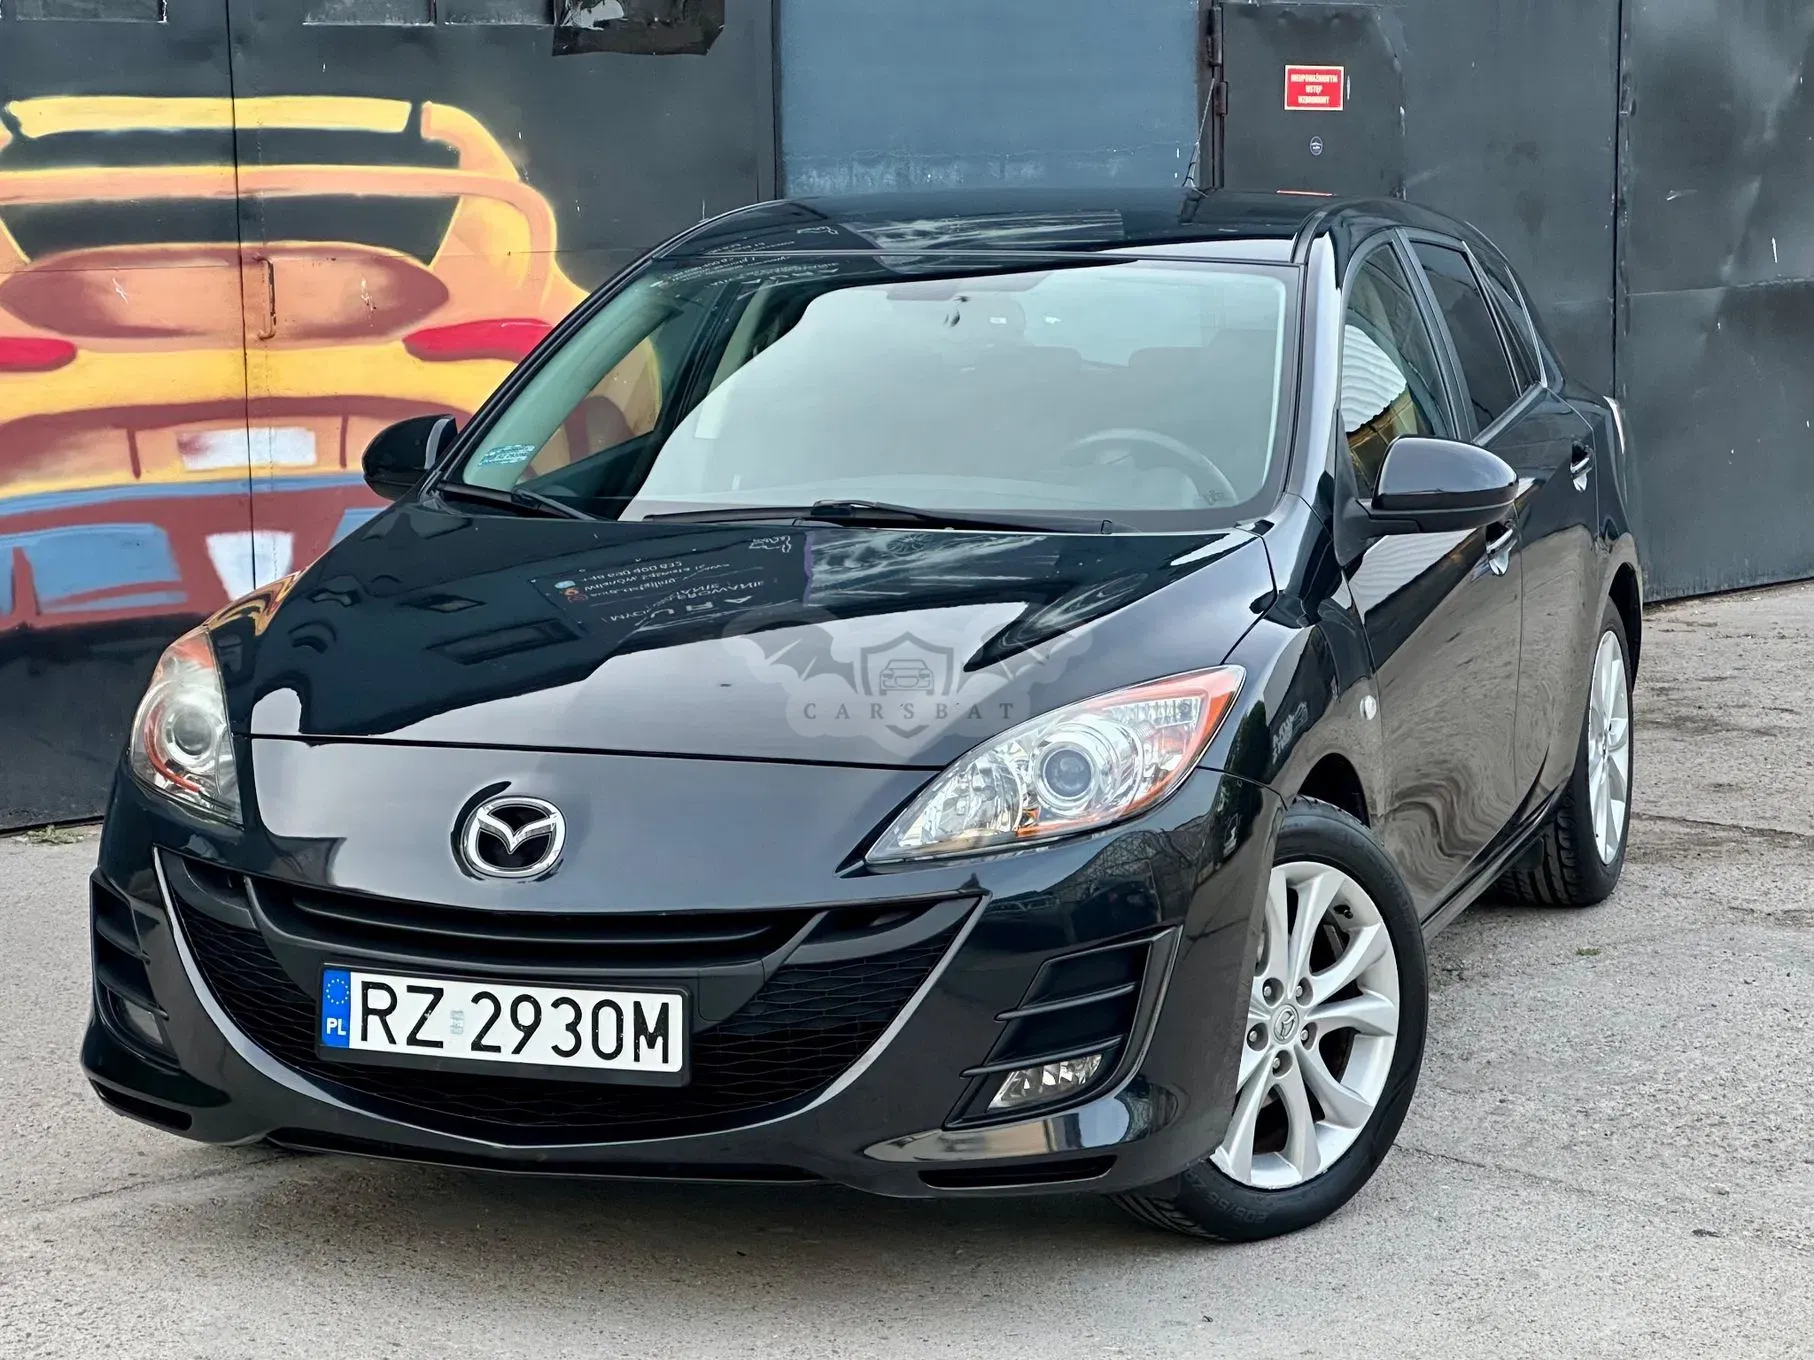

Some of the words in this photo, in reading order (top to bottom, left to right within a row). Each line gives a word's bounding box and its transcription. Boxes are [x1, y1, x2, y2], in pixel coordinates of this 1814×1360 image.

[327, 1017, 346, 1036] PL
[360, 980, 444, 1049] RZ
[470, 991, 670, 1064] 2930M
